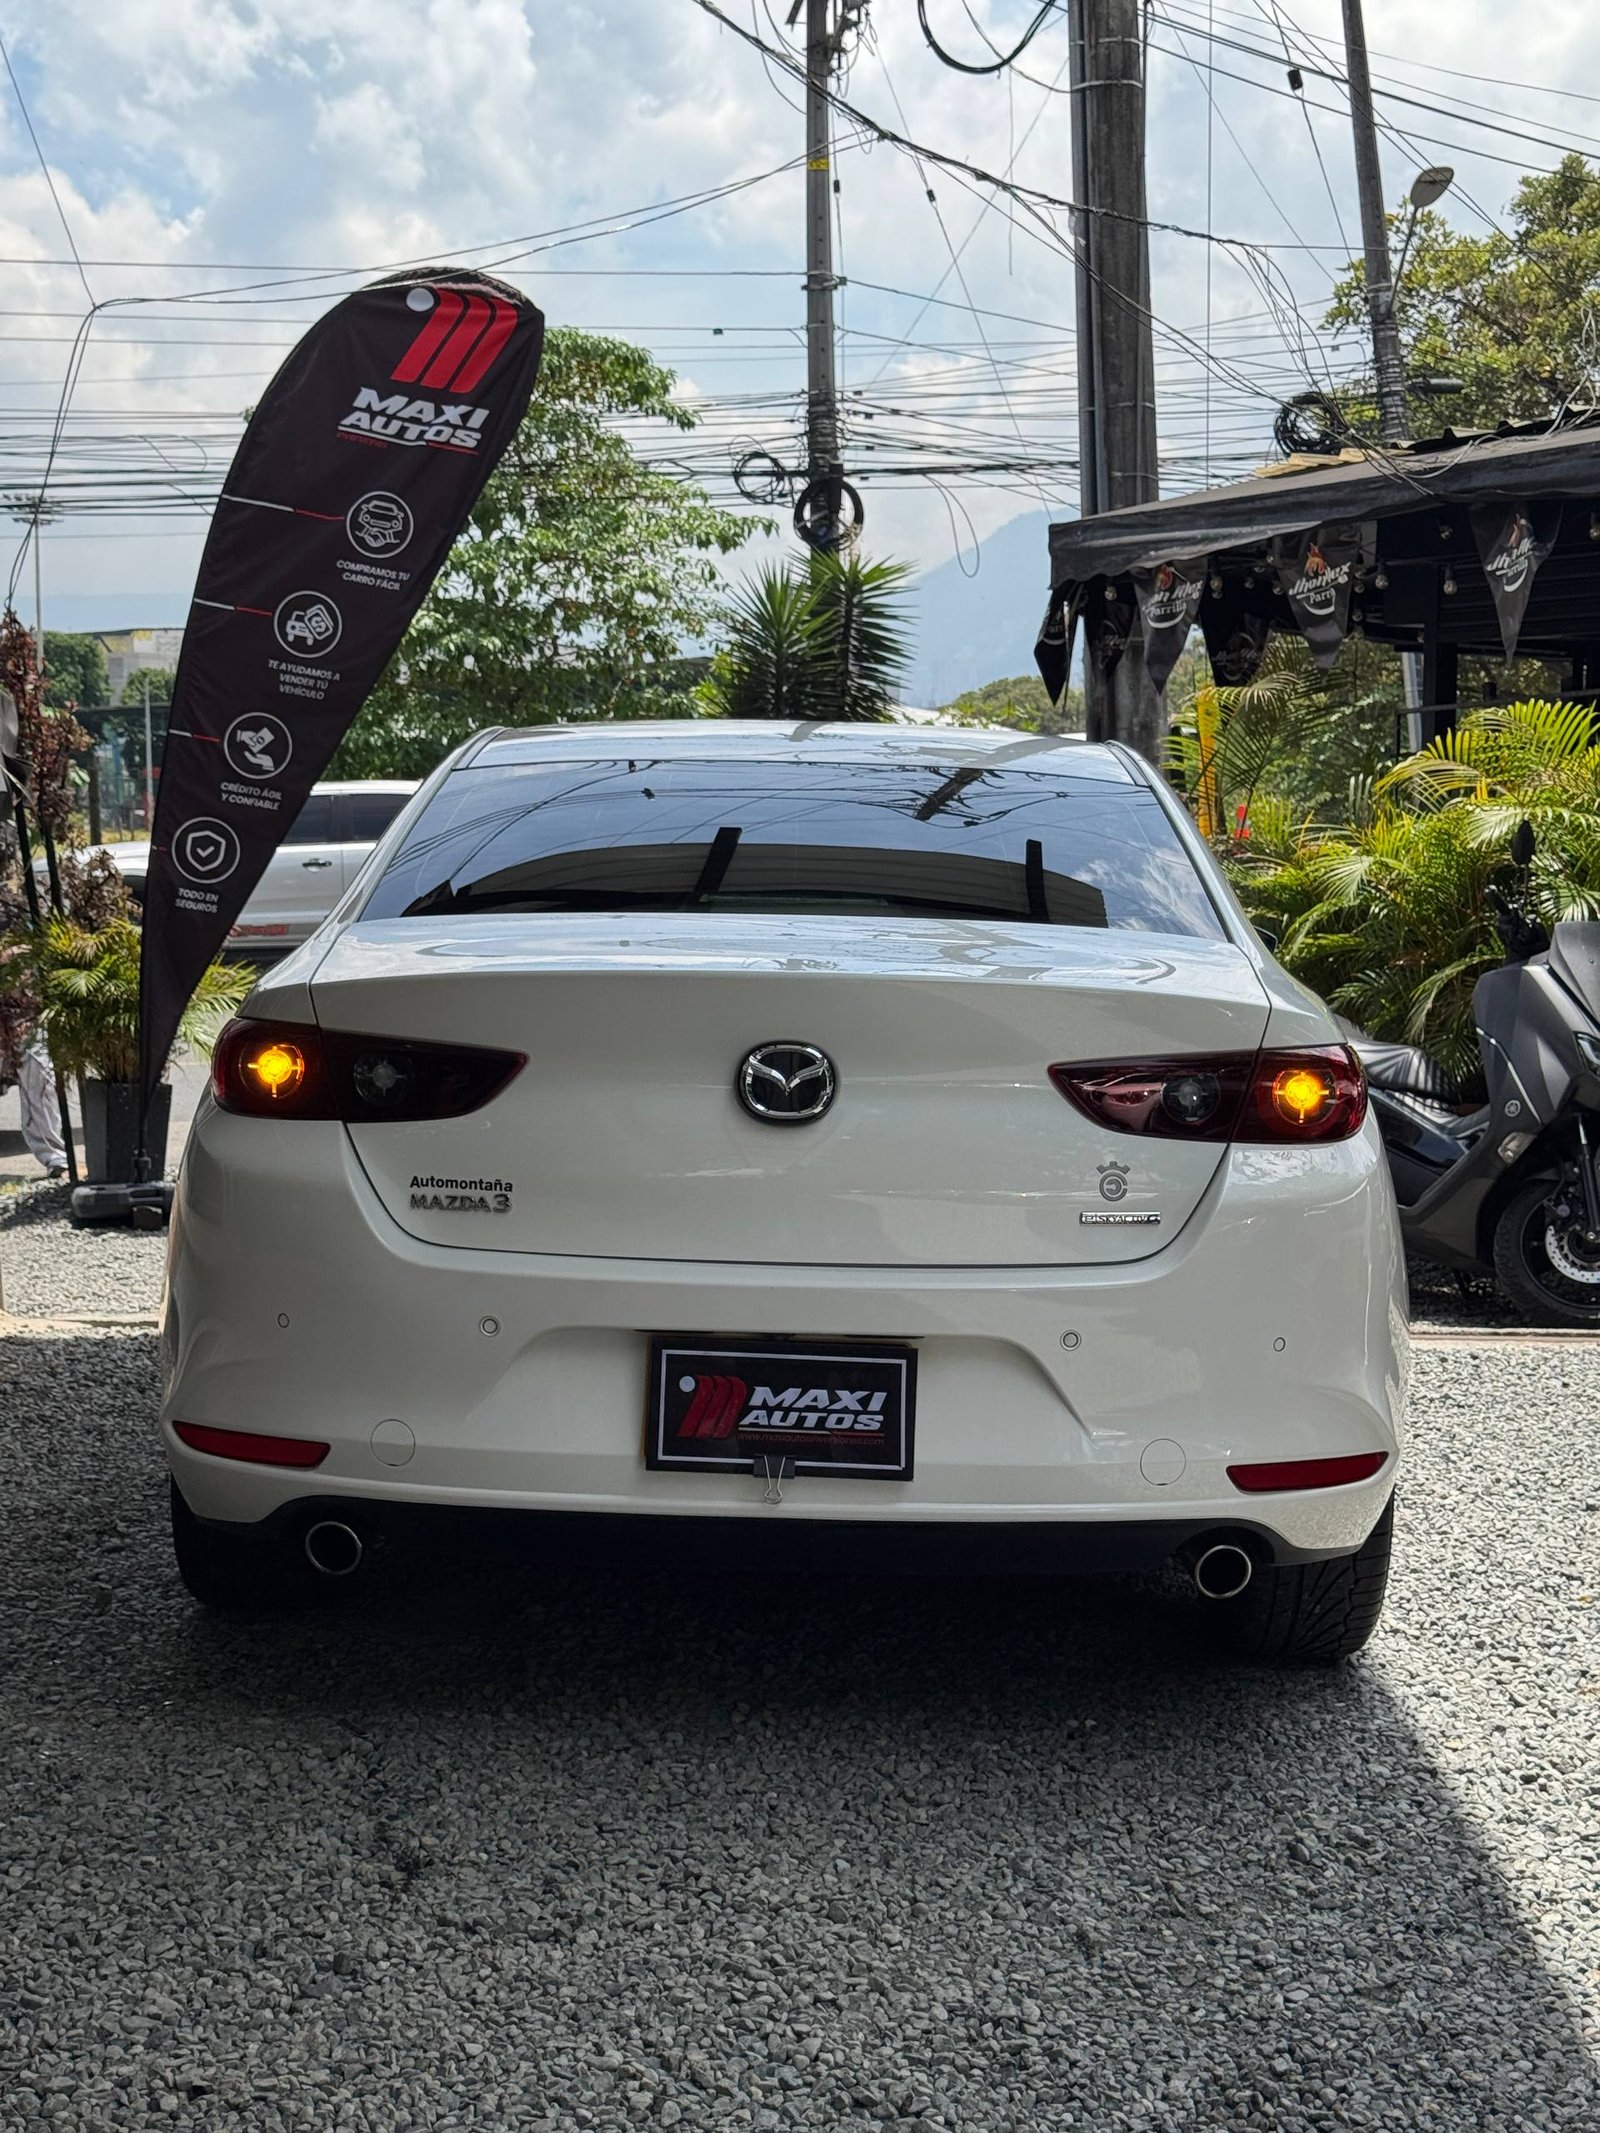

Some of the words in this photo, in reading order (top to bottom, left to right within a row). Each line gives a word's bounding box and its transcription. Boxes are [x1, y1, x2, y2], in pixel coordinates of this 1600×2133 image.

[353, 386, 490, 429] MAXI
[340, 411, 482, 448] AUTOS
[336, 559, 397, 579] COMPRAMOS
[398, 571, 410, 581] TU
[342, 572, 375, 585] CARRO
[376, 578, 400, 591] FÁCIL
[268, 659, 280, 669] TE
[280, 662, 333, 680] AYUDAMOS
[333, 673, 341, 681] A
[280, 673, 315, 688] VENDER
[279, 684, 325, 700] VEHÍCULO
[220, 782, 261, 796] CRÉDITO
[261, 787, 283, 800] ÁGIL
[222, 792, 229, 801] Y
[228, 794, 280, 810] CONFIABLE
[178, 887, 205, 900] TODO
[205, 892, 219, 902] EN
[175, 898, 218, 913] SEGUROS
[409, 1175, 513, 1192] Automontaña
[749, 1386, 888, 1411] MAXI
[738, 1410, 885, 1430] AUTOS
